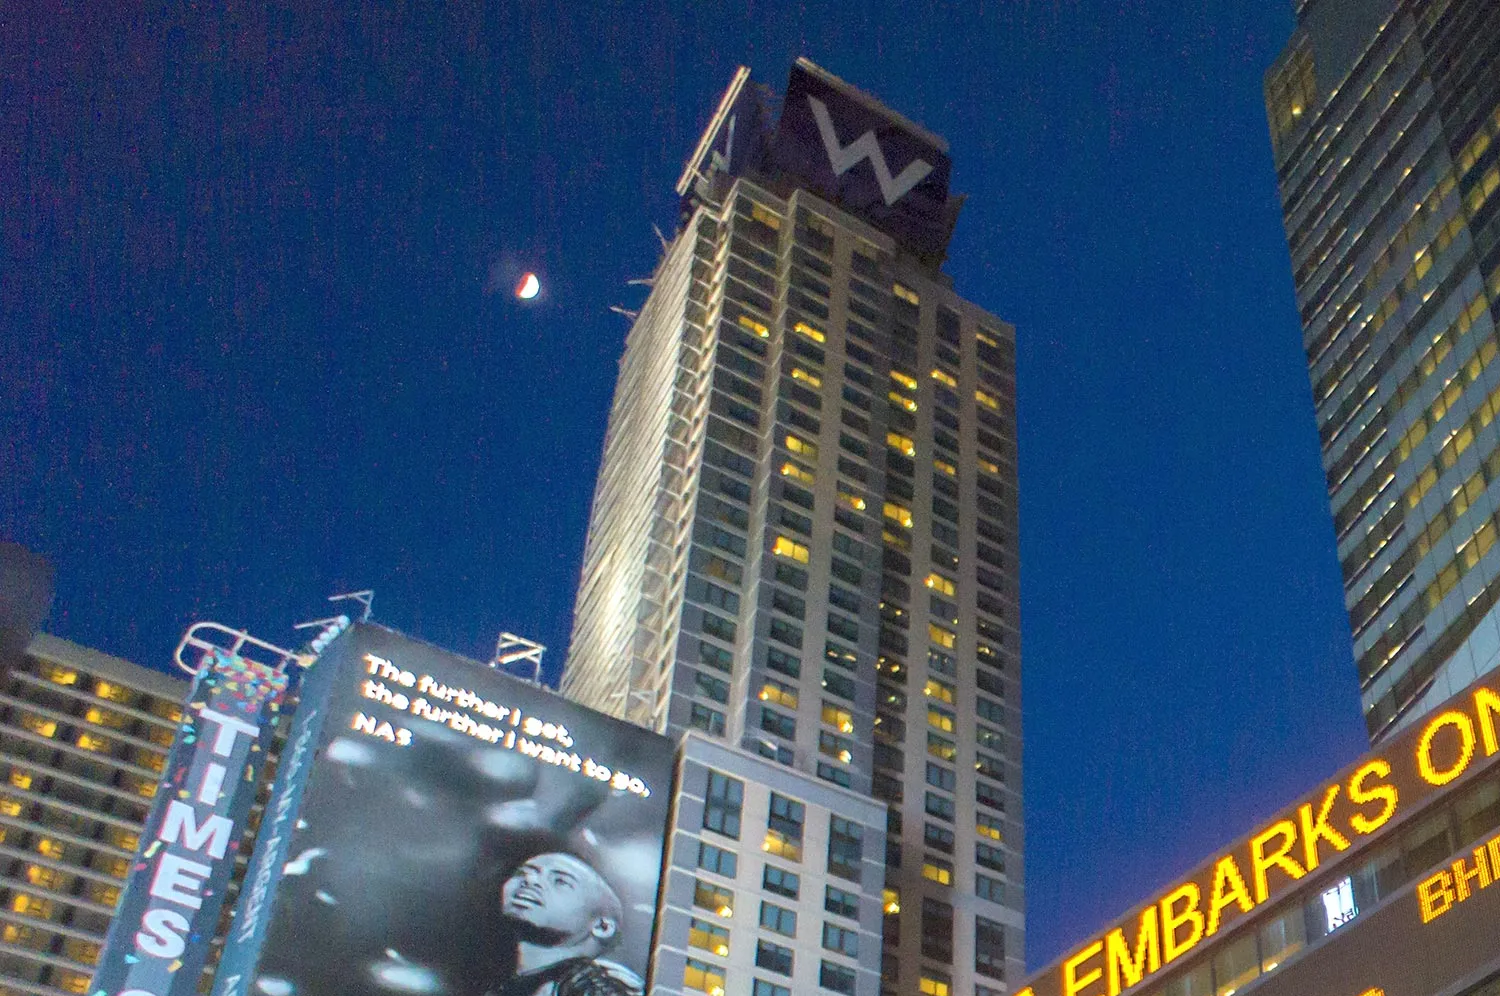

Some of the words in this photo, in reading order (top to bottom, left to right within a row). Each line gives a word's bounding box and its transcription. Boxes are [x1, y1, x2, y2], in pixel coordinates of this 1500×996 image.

[807, 93, 934, 207] W
[352, 711, 414, 747] NAS
[361, 679, 410, 711] the
[410, 697, 504, 743] further
[517, 737, 582, 772] want
[582, 757, 612, 782] to
[362, 652, 416, 688] The
[417, 674, 510, 721] further
[134, 706, 261, 959] TIMES
